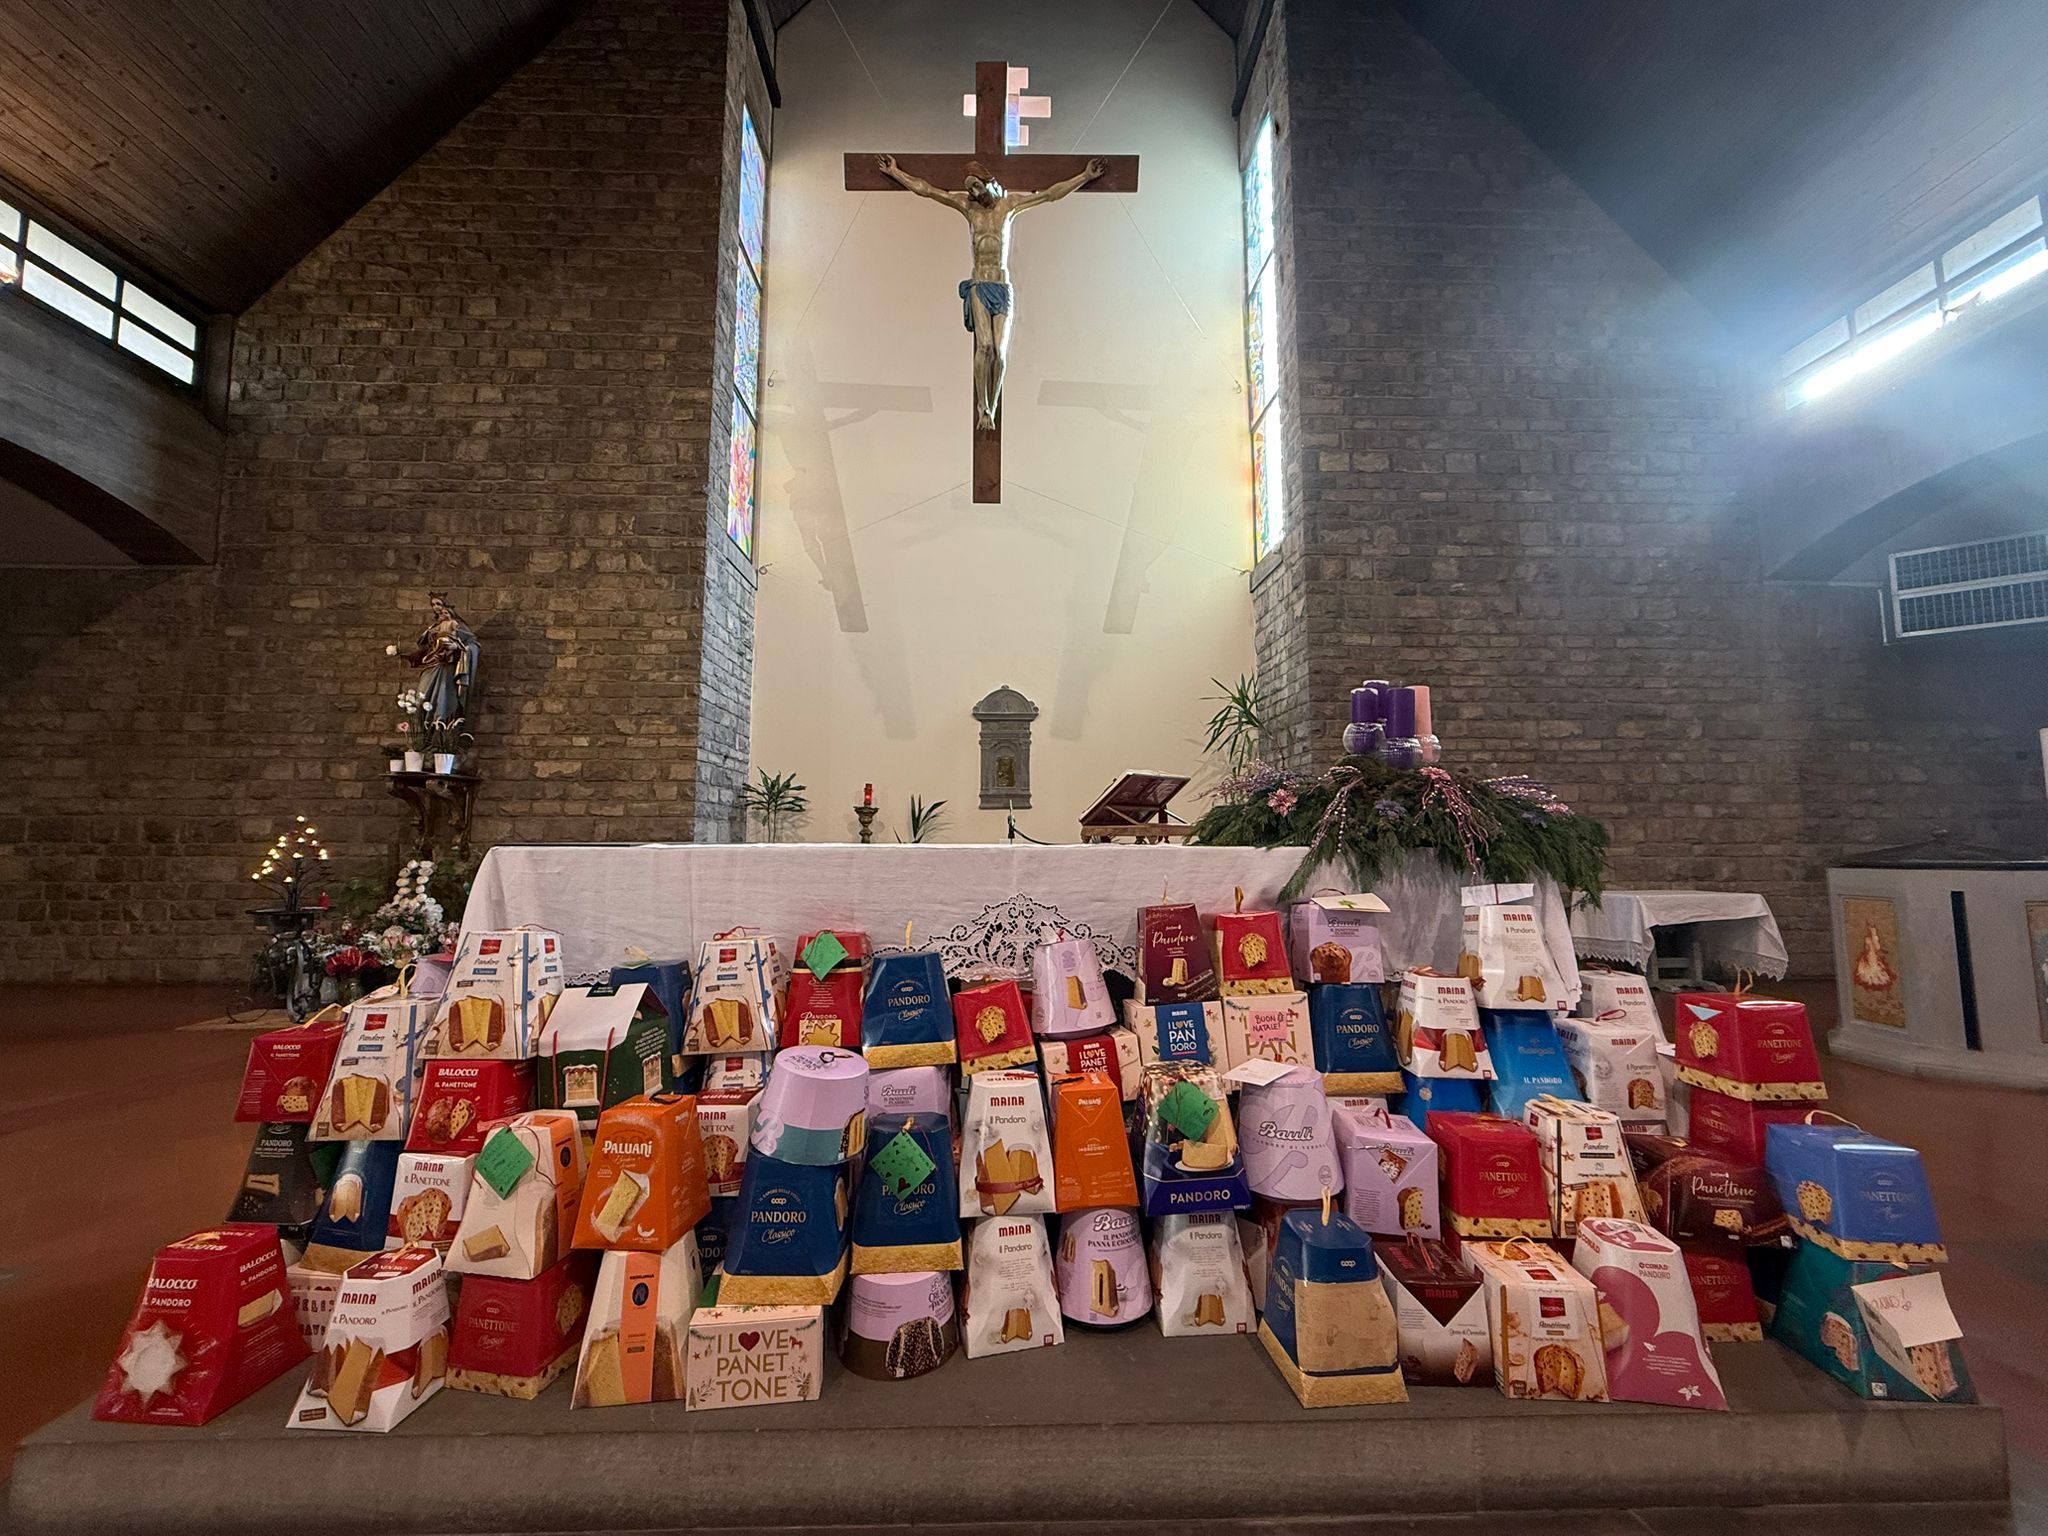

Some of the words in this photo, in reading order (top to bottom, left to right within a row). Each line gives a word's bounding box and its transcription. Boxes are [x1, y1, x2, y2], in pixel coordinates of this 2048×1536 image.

[1503, 913, 1533, 922] MAINA
[1510, 927, 1536, 935] Pandoro
[1152, 930, 1197, 948] Pandoro
[1437, 986, 1465, 995] MAINA
[1616, 987, 1644, 995] MAINA
[888, 995, 930, 1007] PANDORO
[1443, 997, 1468, 1005] PANDORO
[800, 1011, 838, 1021] Pandoro
[1255, 1014, 1275, 1024] BUON
[1252, 1021, 1280, 1032] NATALE!
[1336, 1023, 1380, 1034] PANDORO
[1169, 1031, 1196, 1042] PAN
[1170, 1042, 1197, 1052] DORO
[1757, 1039, 1802, 1049] PANETTONE
[1080, 1057, 1107, 1068] PANET
[438, 1068, 479, 1077] BALOCCO
[441, 1081, 477, 1089] PANETTONE
[881, 1084, 917, 1096] Bauli
[990, 1096, 1025, 1107] MAINA
[1344, 1099, 1370, 1107] MAINA
[994, 1115, 1027, 1124] Pandoro
[700, 1124, 735, 1133] NETTONE
[1257, 1121, 1314, 1141] Bauli
[260, 1139, 293, 1147] PANDORO
[602, 1140, 653, 1158] PALUANI
[414, 1162, 444, 1173] MAINA
[410, 1174, 450, 1187] PANETTONE
[1478, 1172, 1530, 1182] PANETTONE
[881, 1183, 935, 1197] PAORO
[1689, 1176, 1757, 1197] Panettone
[770, 1197, 787, 1205] coop
[1169, 1189, 1231, 1203] PANDORO
[893, 1199, 926, 1215] Classico
[751, 1211, 807, 1223] PANDORO
[1188, 1214, 1221, 1224] MAINA
[761, 1227, 798, 1244] Classico
[998, 1224, 1032, 1237] MAINA
[1194, 1231, 1223, 1240] Pandoro
[1003, 1243, 1033, 1254] Pandoro
[240, 1250, 277, 1273] BALOCCO
[1340, 1260, 1356, 1268] coop
[248, 1264, 278, 1283] PANDORO
[1639, 1269, 1671, 1280] PANDORO
[148, 1278, 198, 1290] BALOCCO
[412, 1269, 442, 1294] MAINA
[341, 1293, 377, 1305] MAINA
[1424, 1289, 1458, 1299] MAINA
[150, 1298, 192, 1307] PANDORO
[339, 1314, 377, 1326] PANDORO
[469, 1317, 518, 1333] PANETTONE
[717, 1334, 722, 1347] I
[716, 1352, 789, 1377] PANET
[716, 1375, 788, 1402] TONE
